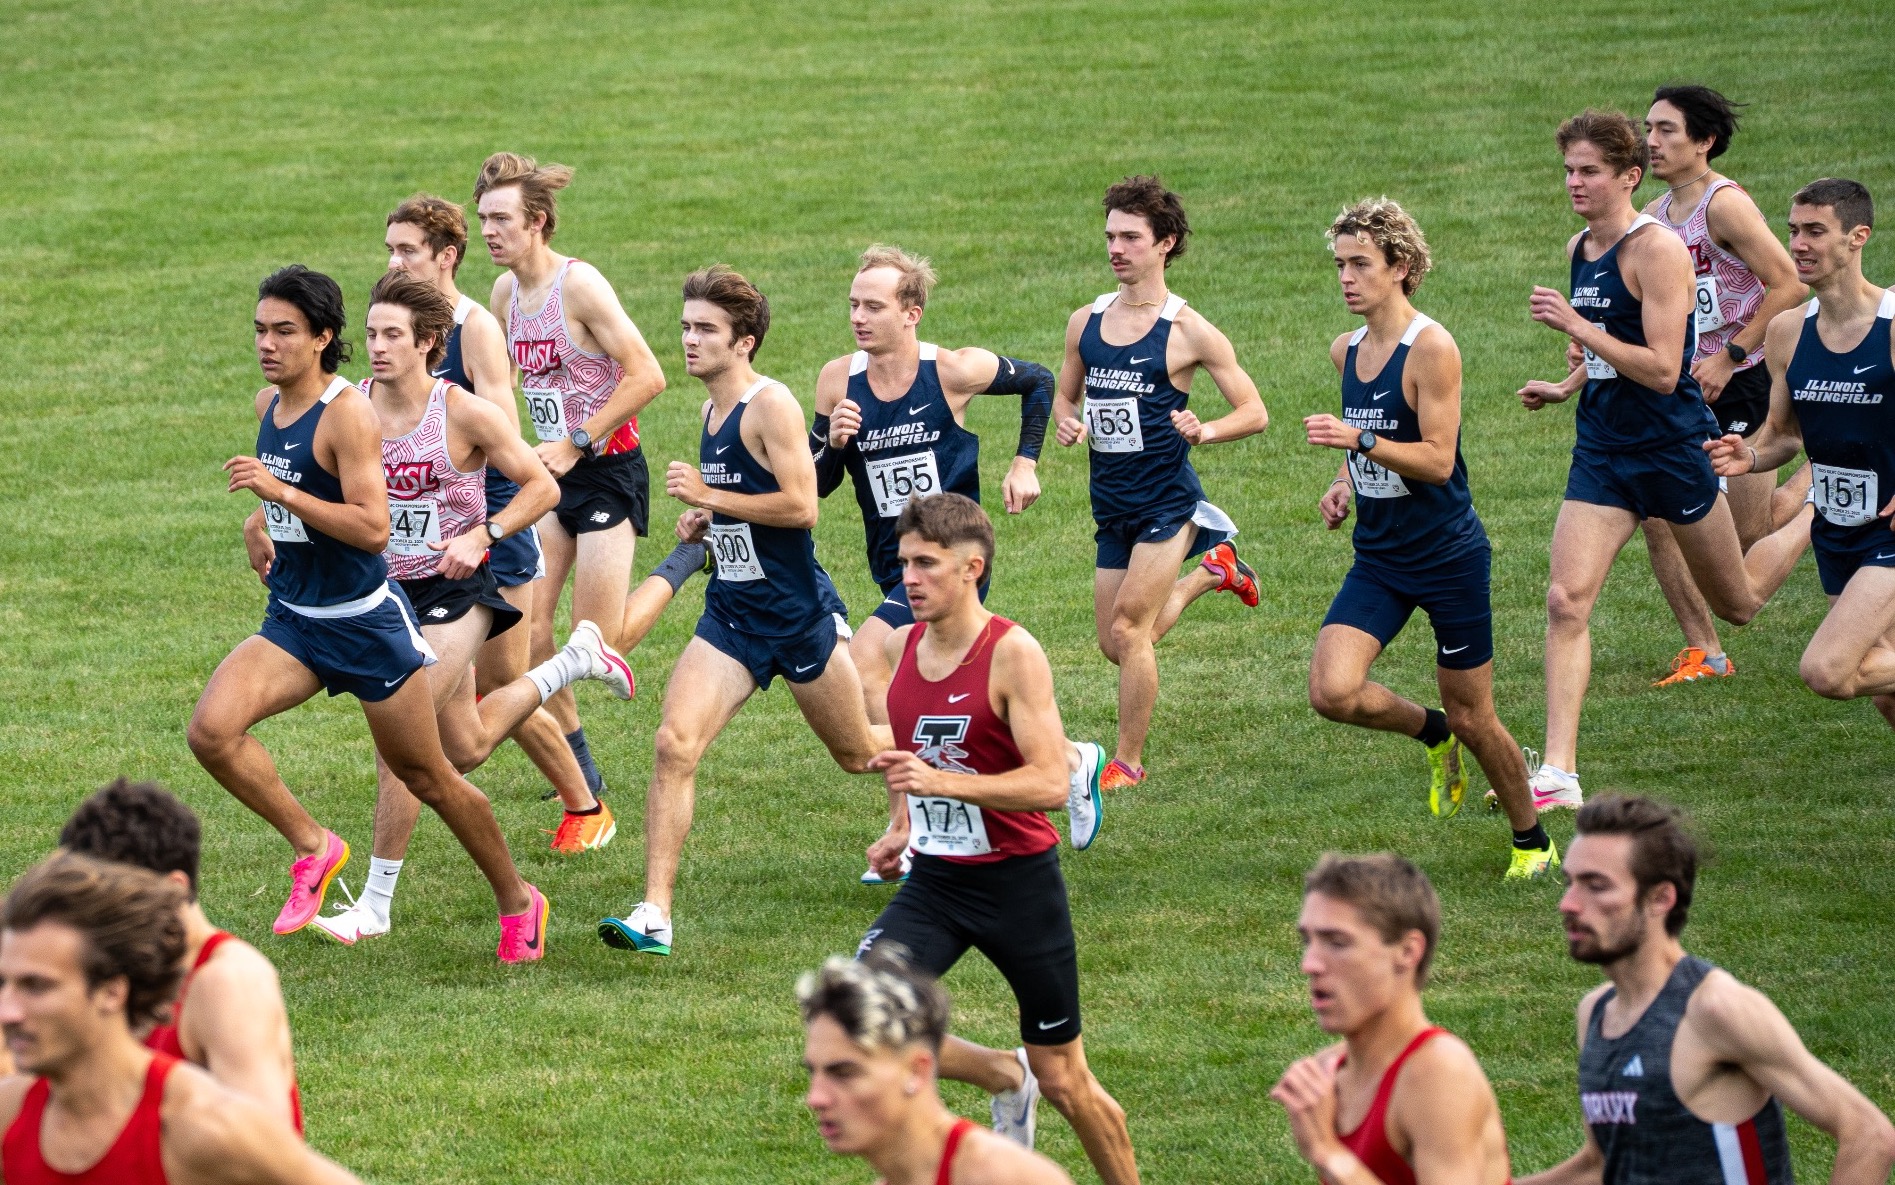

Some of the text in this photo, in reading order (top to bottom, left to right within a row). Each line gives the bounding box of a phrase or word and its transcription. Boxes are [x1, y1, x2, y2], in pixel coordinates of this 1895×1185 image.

[1697, 288, 1713, 314] 9
[514, 337, 562, 376] UMSL
[1085, 376, 1156, 394] SPRINGFIELD
[1090, 366, 1144, 382] ILLINOIS
[1804, 379, 1867, 393] ILLINOIS
[1793, 389, 1884, 404] SPRINGFIELD
[1086, 408, 1134, 436] 153
[1344, 407, 1385, 419] ILLINOIS
[857, 430, 941, 452] SPRINGFIELD
[866, 422, 926, 441] ILLINOIS
[260, 452, 292, 470] ILLINOIS
[384, 460, 440, 500] MSL
[876, 462, 933, 498] 155
[1820, 476, 1866, 510] 151
[713, 534, 750, 563] 300
[916, 800, 973, 834] 171
